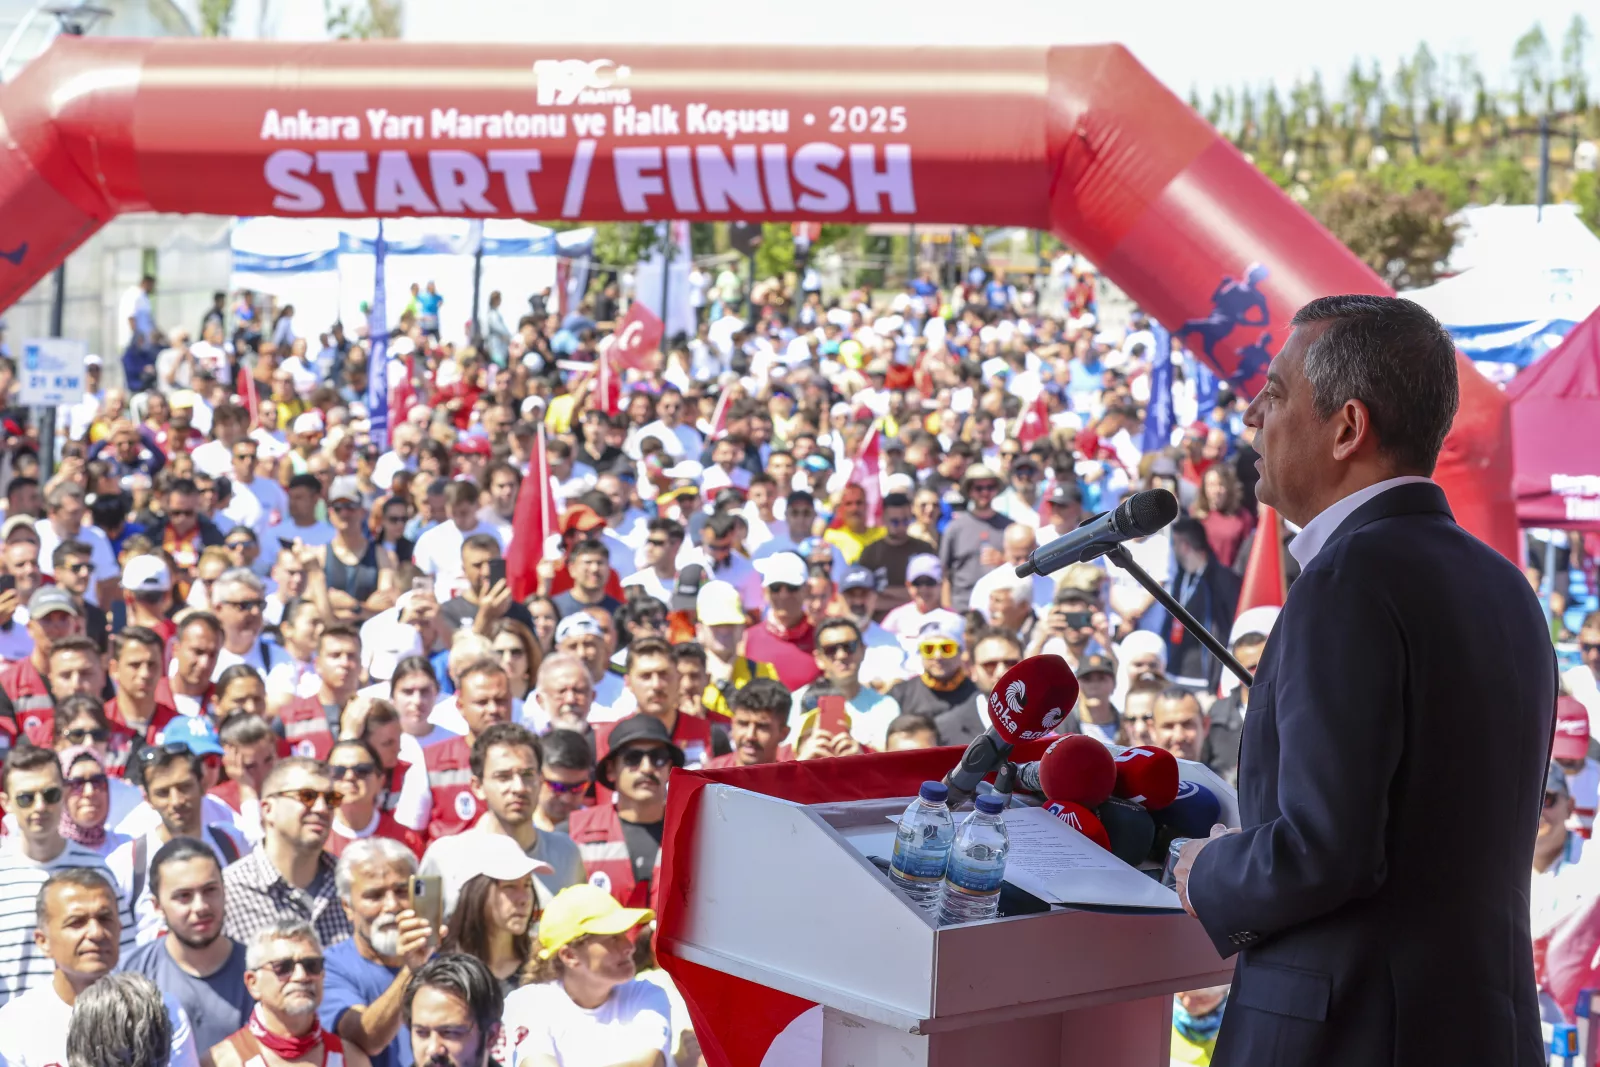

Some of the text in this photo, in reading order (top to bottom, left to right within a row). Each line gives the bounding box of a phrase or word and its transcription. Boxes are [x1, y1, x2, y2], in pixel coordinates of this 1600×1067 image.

[260, 103, 908, 140] Ankara Yarı Maratonu ve Halk Koşusu 2025
[264, 139, 917, 218] START / FINISH
[989, 691, 1018, 732] anka
